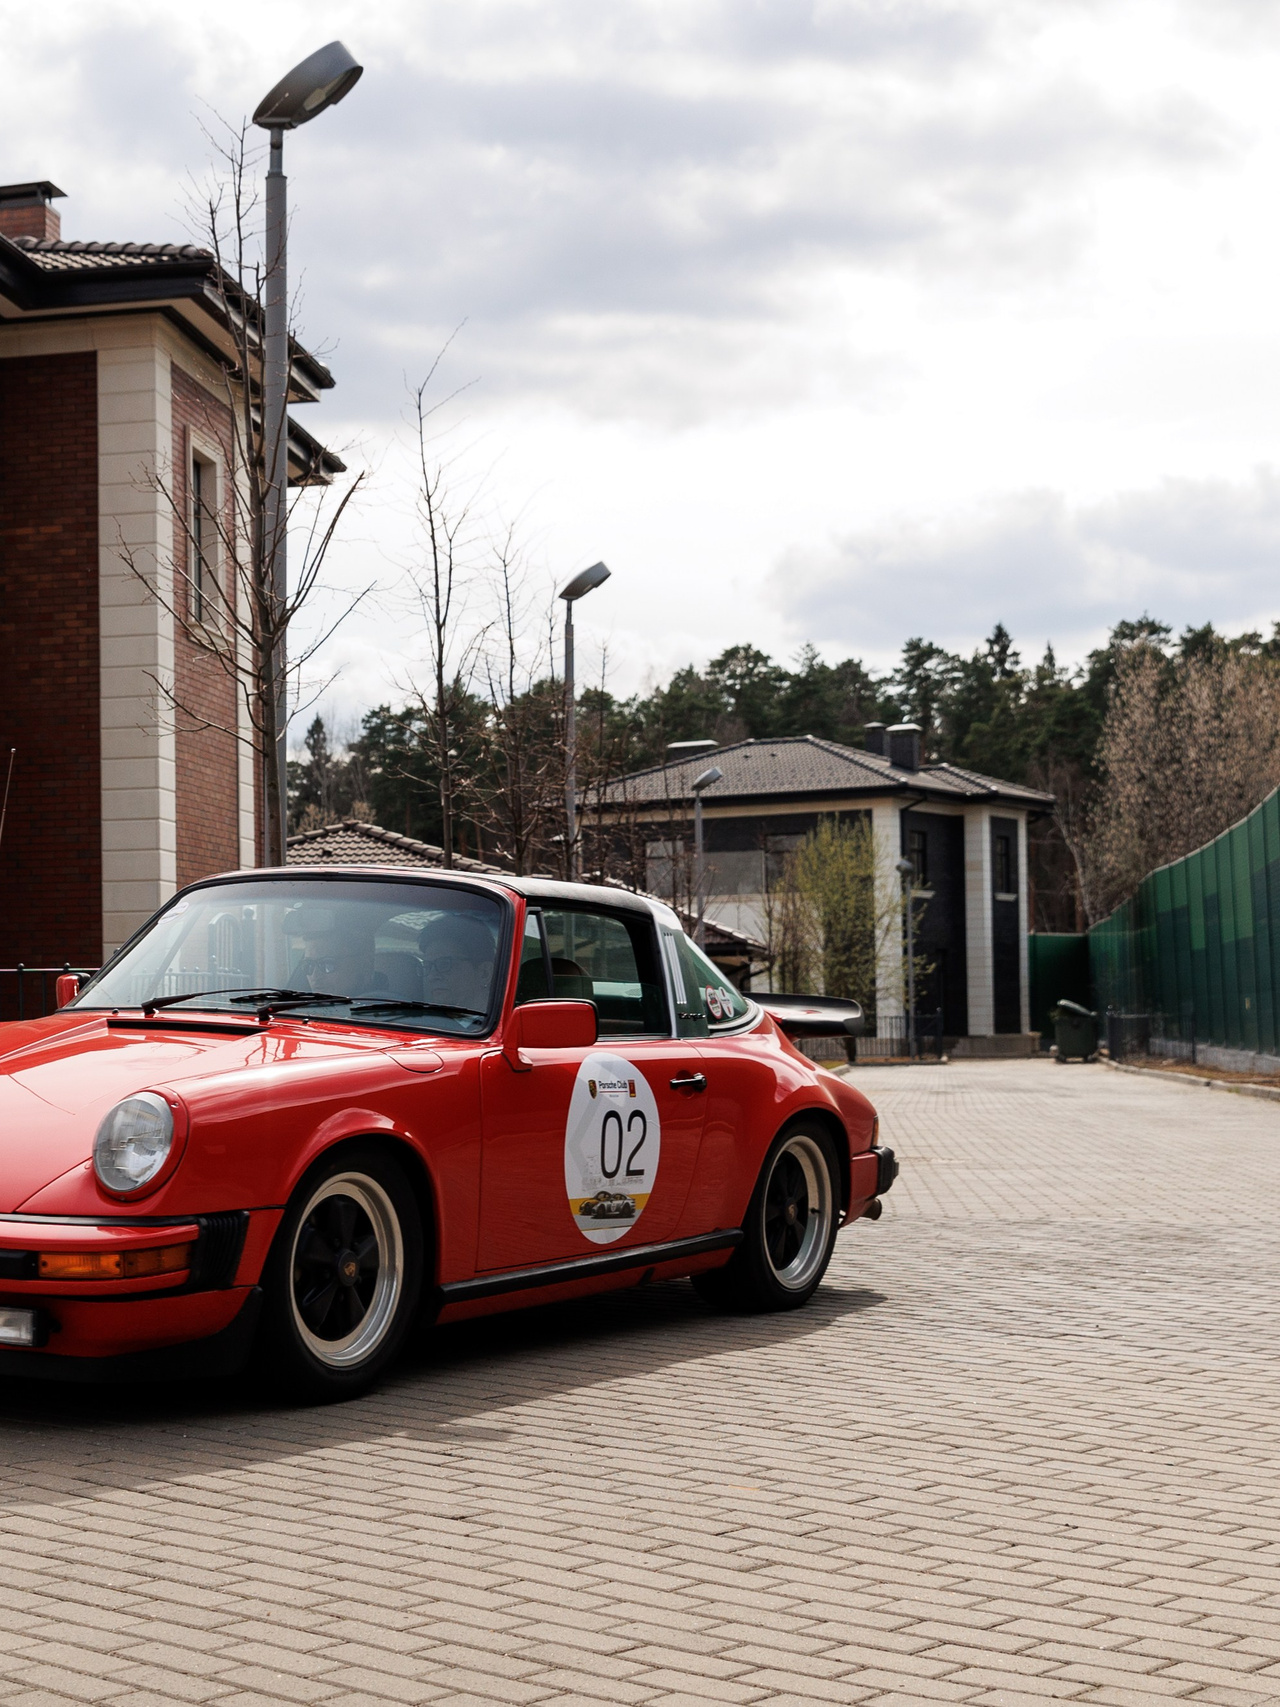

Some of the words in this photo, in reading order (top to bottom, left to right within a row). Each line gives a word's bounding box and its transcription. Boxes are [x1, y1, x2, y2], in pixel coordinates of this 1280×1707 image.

[598, 1081, 617, 1089] Porsche
[617, 1080, 628, 1089] Club
[600, 1109, 647, 1179] 02
